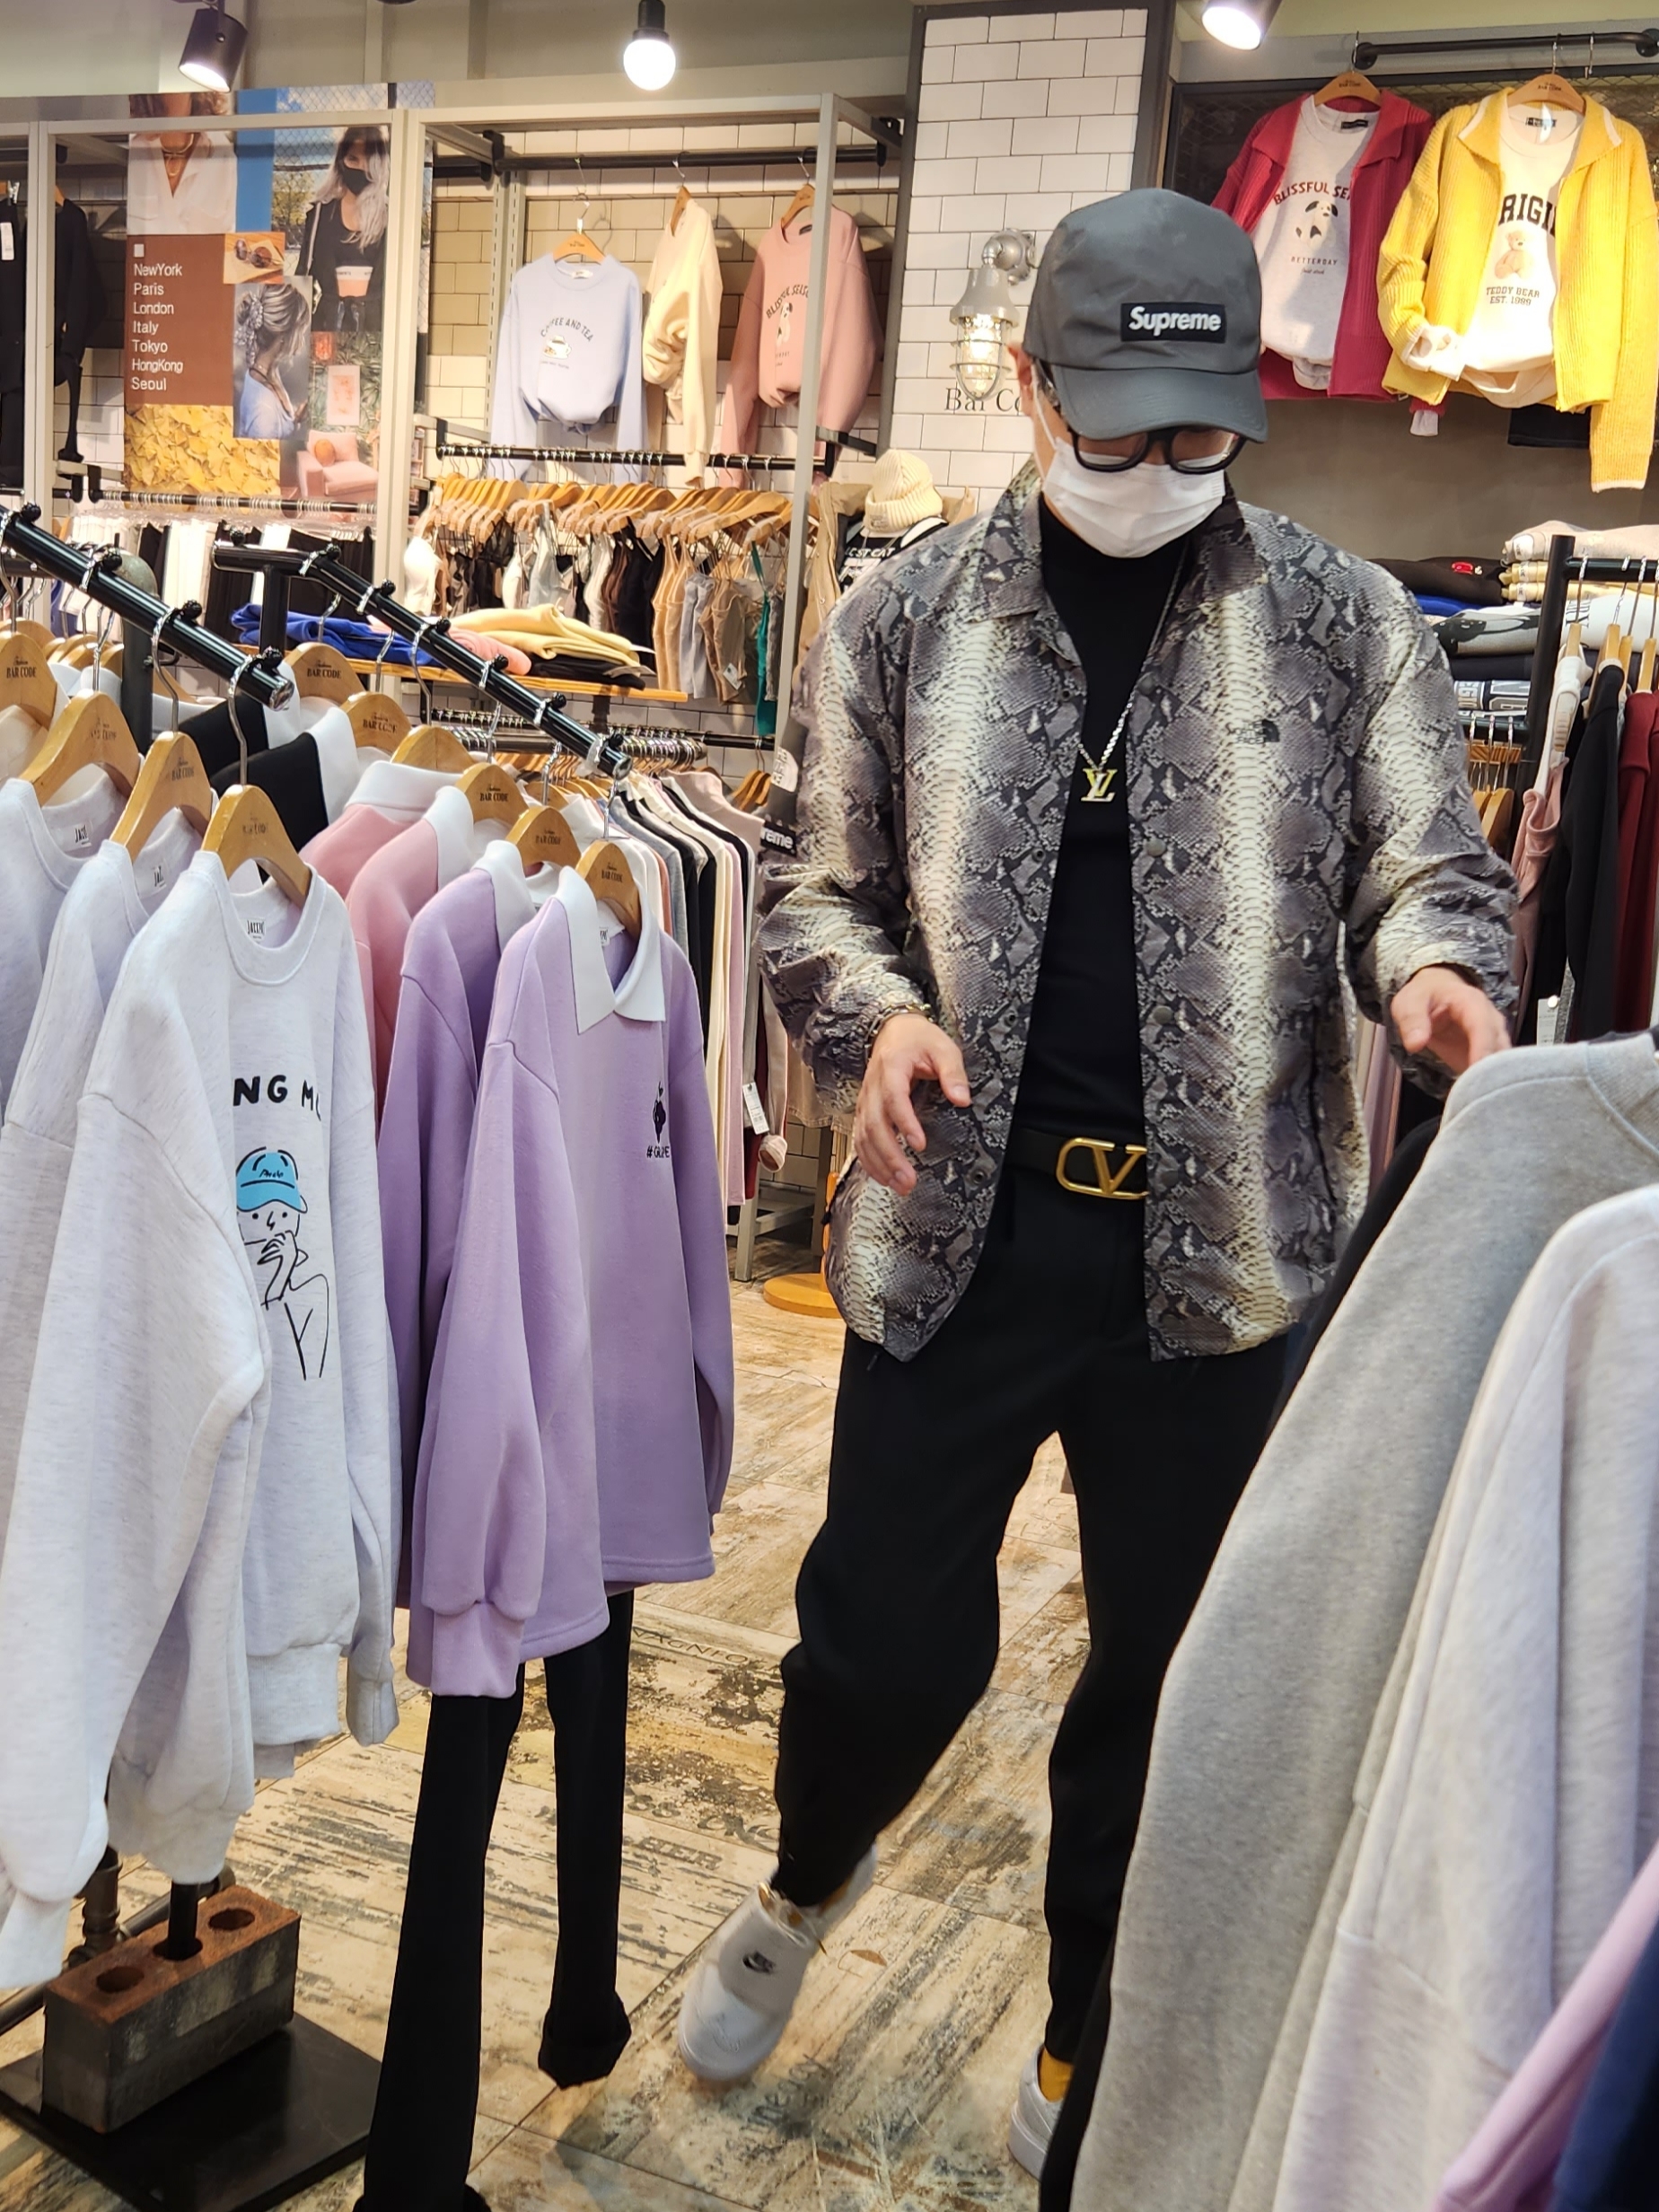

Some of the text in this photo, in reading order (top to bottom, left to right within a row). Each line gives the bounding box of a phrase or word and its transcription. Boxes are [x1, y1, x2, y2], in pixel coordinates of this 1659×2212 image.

[1273, 181, 1330, 206] BLISSFUL
[134, 263, 182, 276] NewYork
[134, 282, 164, 295] Paris
[1486, 285, 1540, 298] TEDDY BEAR
[133, 302, 174, 314] London
[133, 320, 159, 335] Italy
[1128, 306, 1221, 336] Supreme
[566, 318, 581, 330] AND
[581, 325, 594, 342] TEA
[132, 339, 168, 355] Tokyo
[132, 358, 183, 373] HongKong
[131, 376, 167, 391] Seoul
[6, 666, 37, 679] BAR CODE
[307, 668, 341, 680] BAR CODE
[363, 719, 377, 730] BAR
[479, 792, 508, 803] BAR CODE
[233, 1075, 288, 1107] NG
